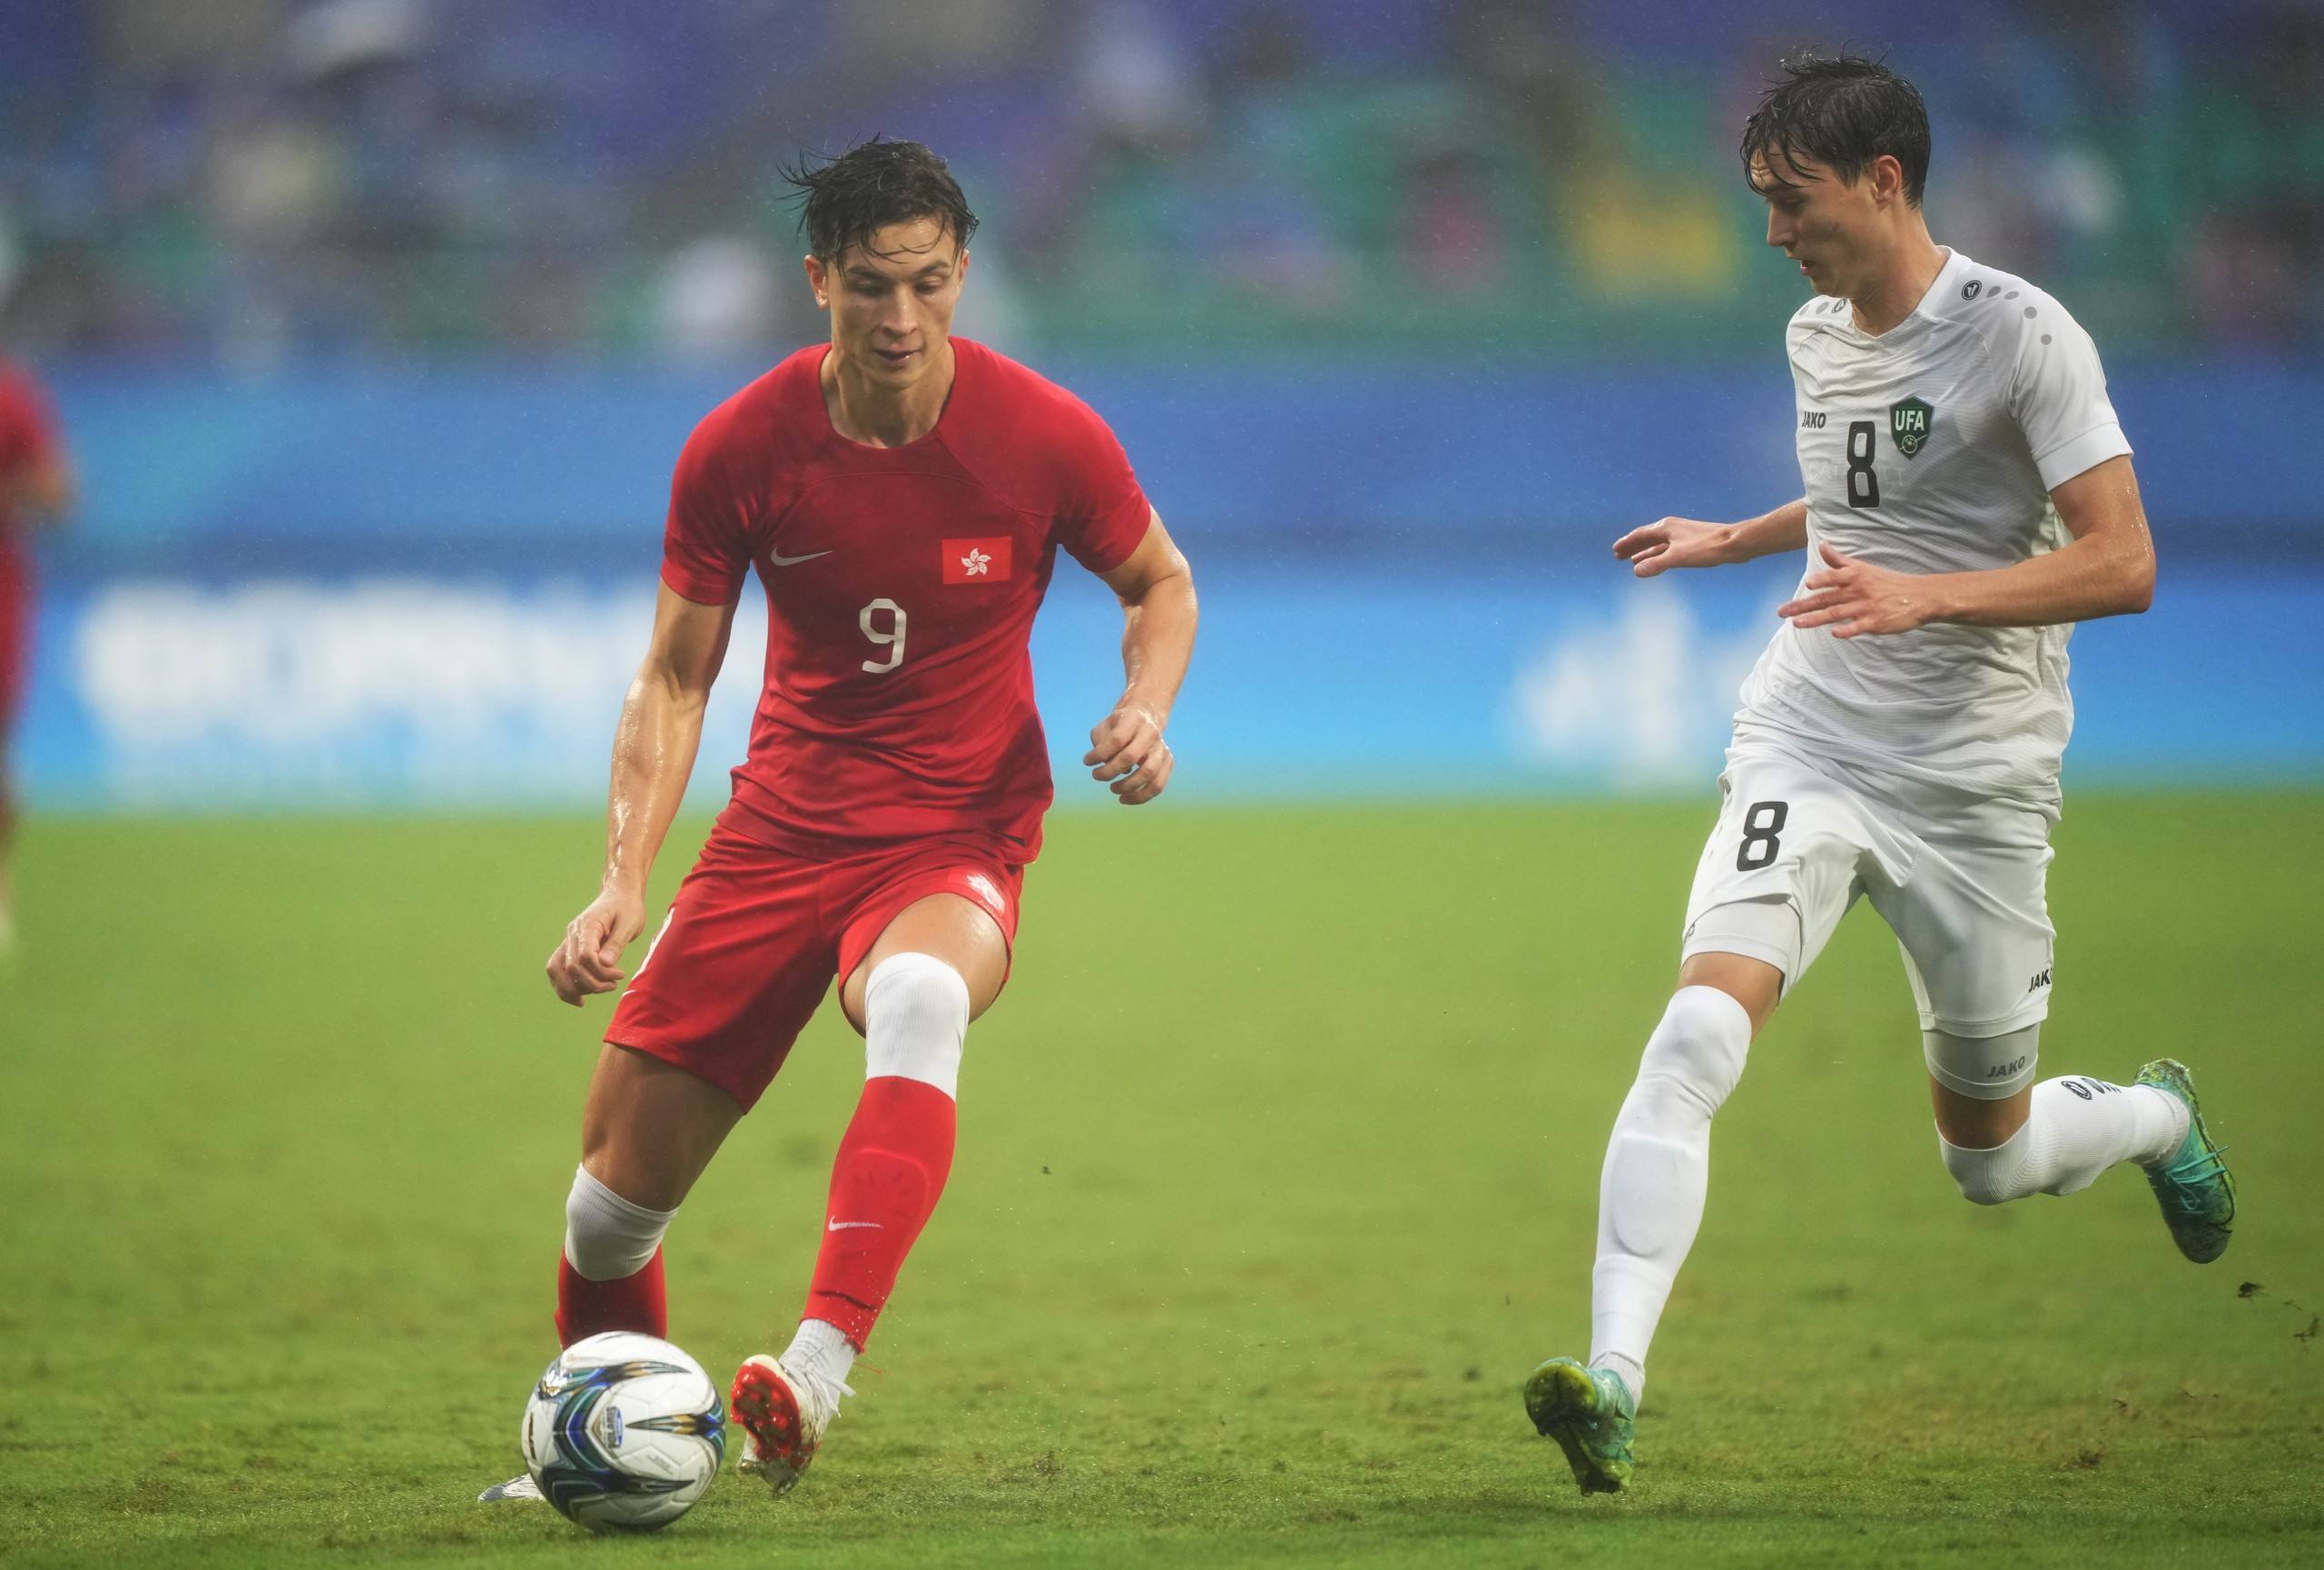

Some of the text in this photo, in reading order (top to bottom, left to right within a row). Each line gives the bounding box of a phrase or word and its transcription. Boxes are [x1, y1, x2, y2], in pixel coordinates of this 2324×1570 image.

[1801, 411, 1827, 429] JAKO
[1895, 410, 1925, 431] UFA
[1847, 421, 1880, 508] 8
[860, 598, 907, 674] 9
[1737, 801, 1788, 872] 8
[1986, 1055, 2025, 1078] JAKO
